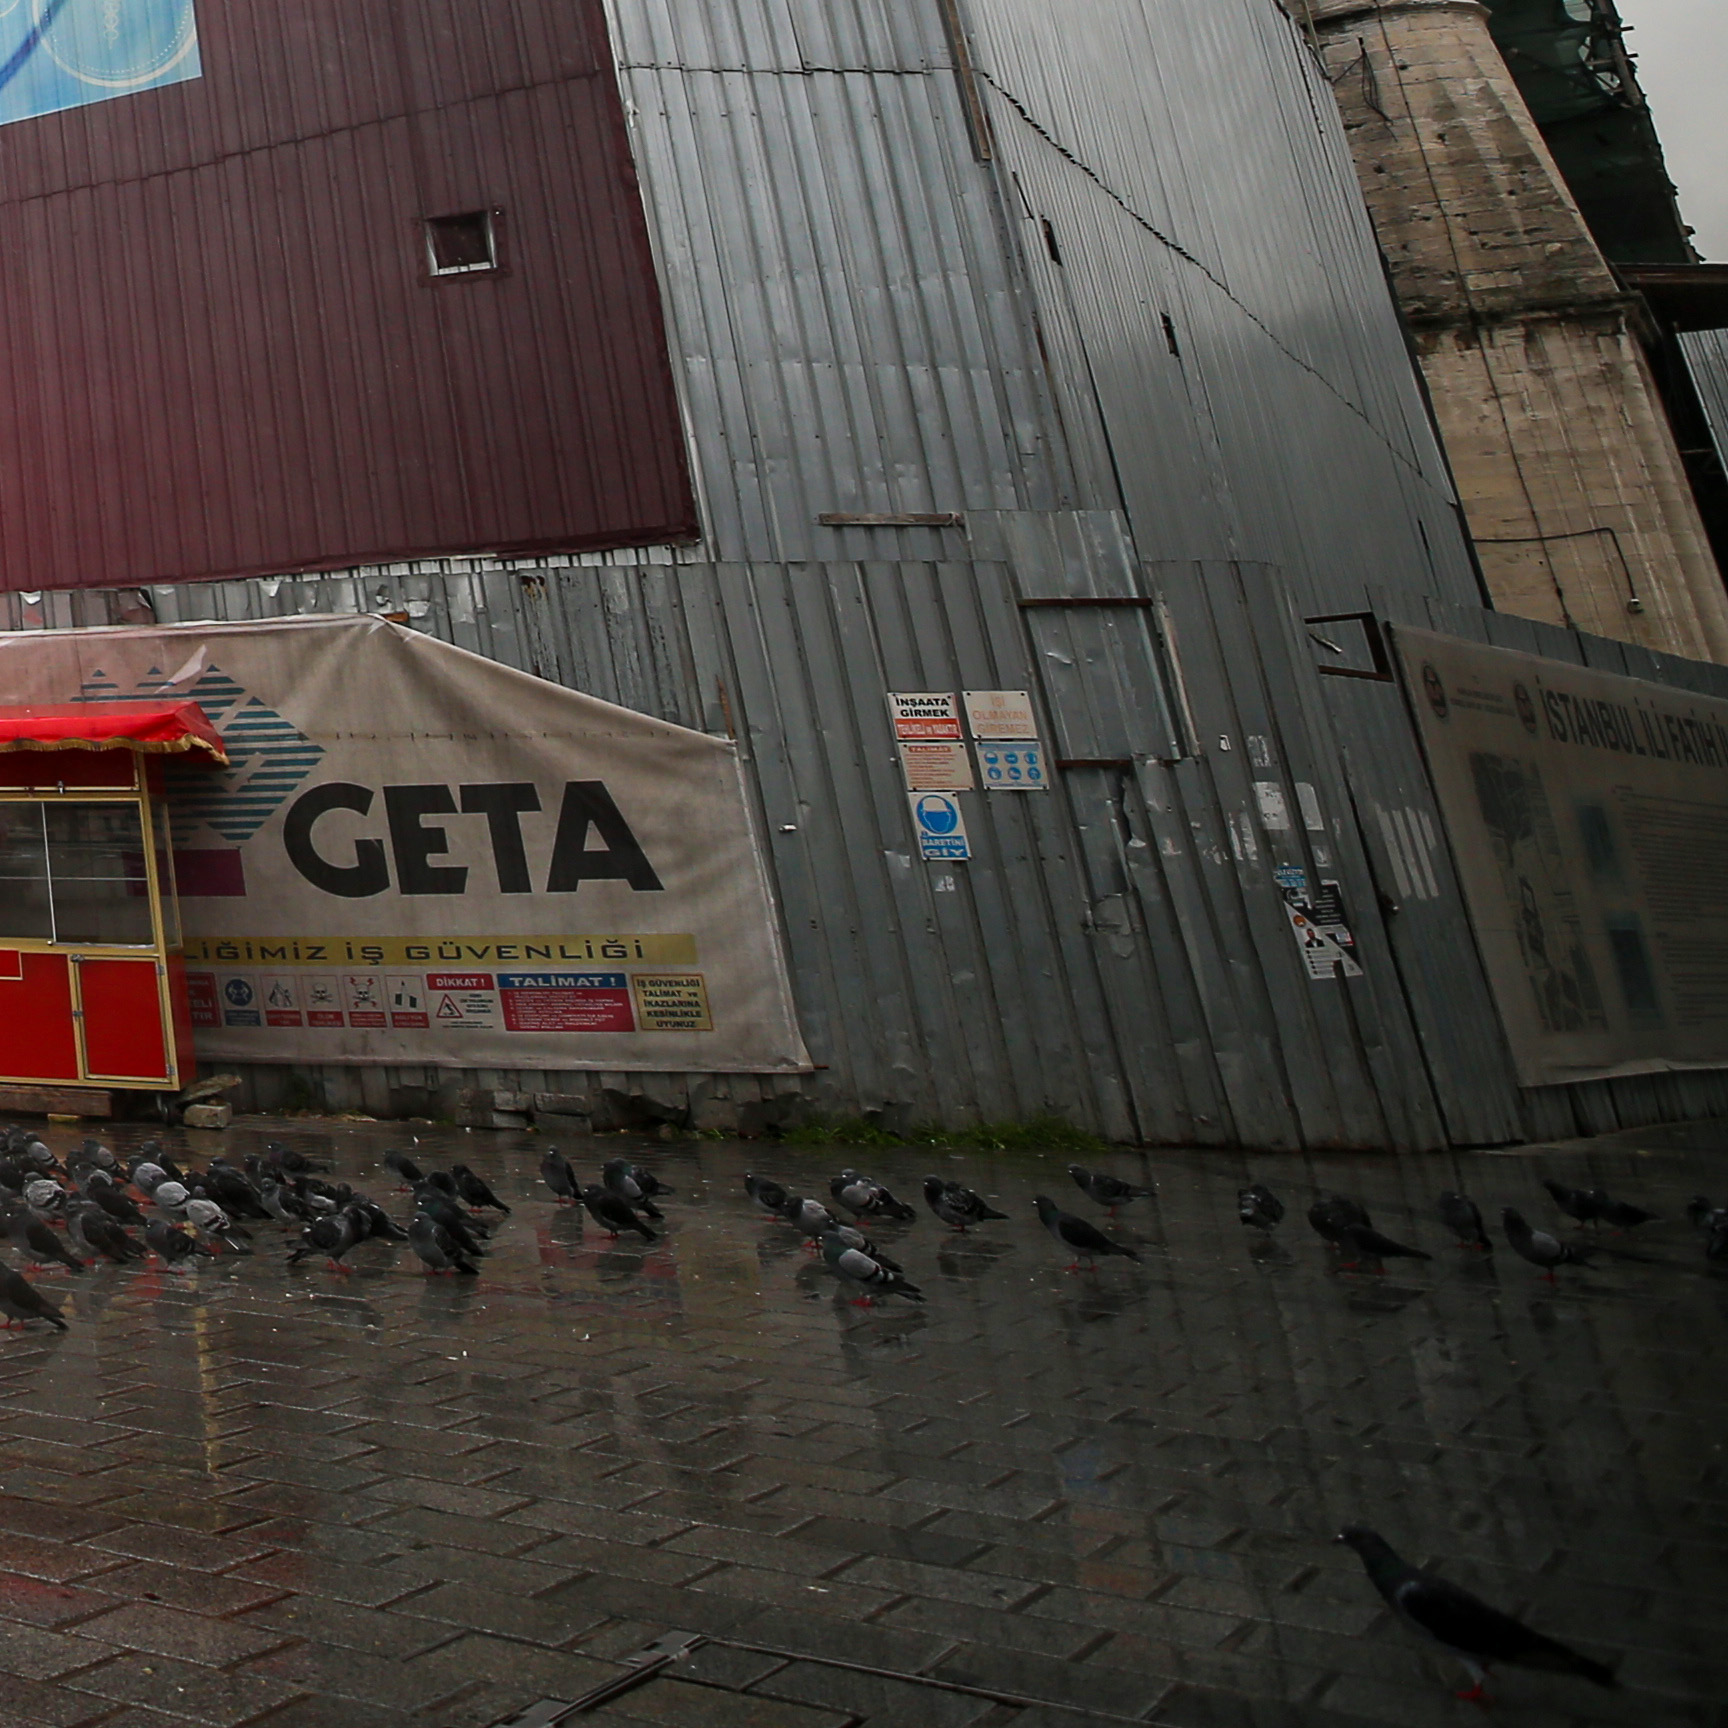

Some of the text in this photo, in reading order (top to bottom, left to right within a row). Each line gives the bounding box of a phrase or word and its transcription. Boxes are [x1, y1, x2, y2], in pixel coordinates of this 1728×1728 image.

[895, 696, 950, 708] İNŞAATA
[900, 708, 950, 718] GİRMEK
[1535, 674, 1646, 757] İSTANBUL
[282, 779, 665, 898] GETA
[345, 941, 385, 966] İŞ
[404, 939, 644, 961] GÜVENLİĞİ
[436, 976, 478, 988] DİKKAT
[509, 974, 604, 988] TALİMAT
[643, 989, 682, 998] TALİMAT
